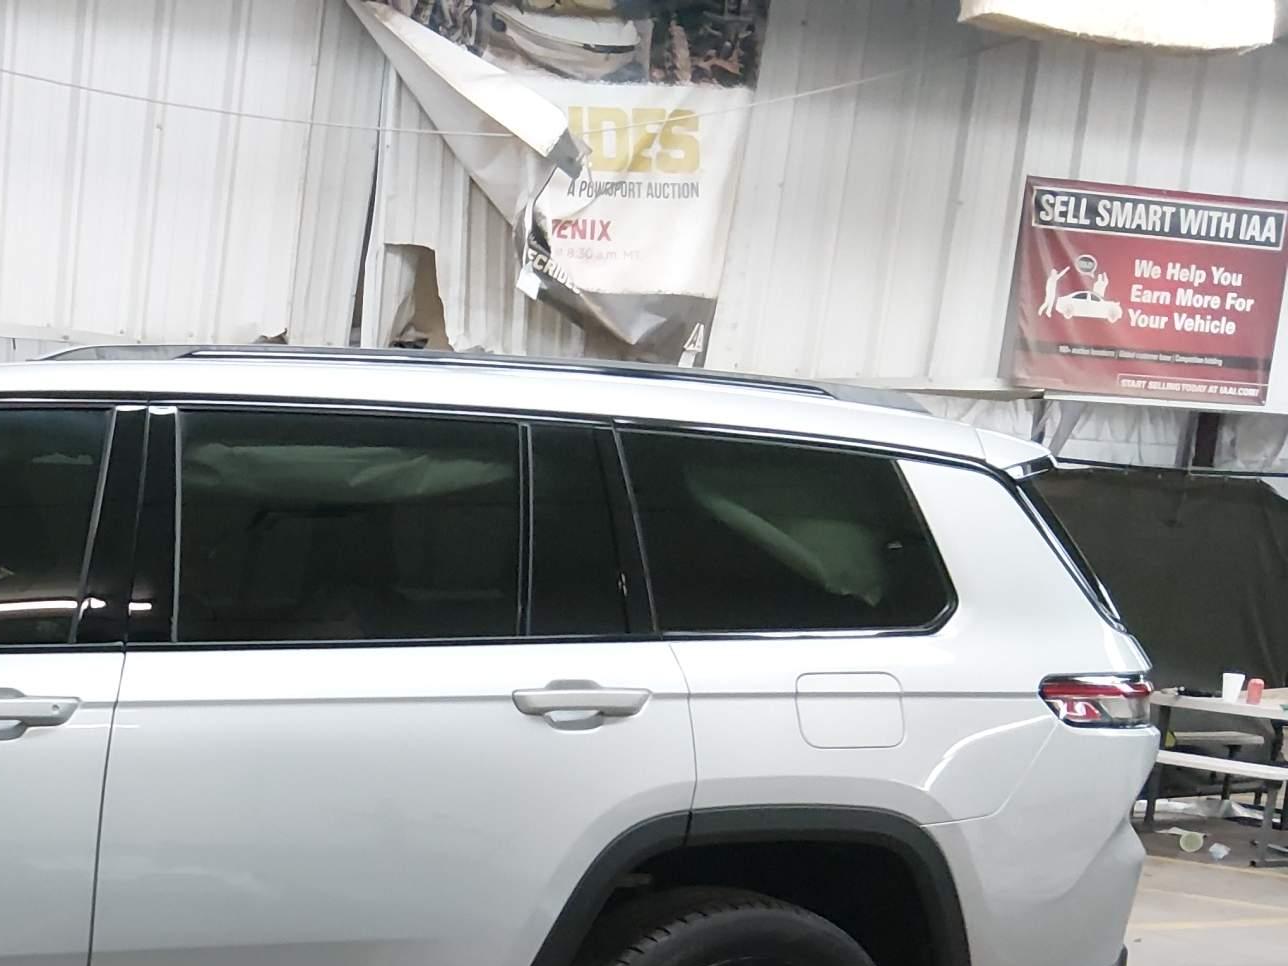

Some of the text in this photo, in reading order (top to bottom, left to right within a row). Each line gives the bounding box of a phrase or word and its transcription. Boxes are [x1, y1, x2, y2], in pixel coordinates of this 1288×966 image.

[646, 181, 700, 199] AUCTION
[1039, 194, 1277, 243] SELL SMART WITH IAA
[1134, 258, 1243, 287] We Help You
[1130, 284, 1255, 312] Earn More For
[1128, 308, 1237, 335] Your Vehicle
